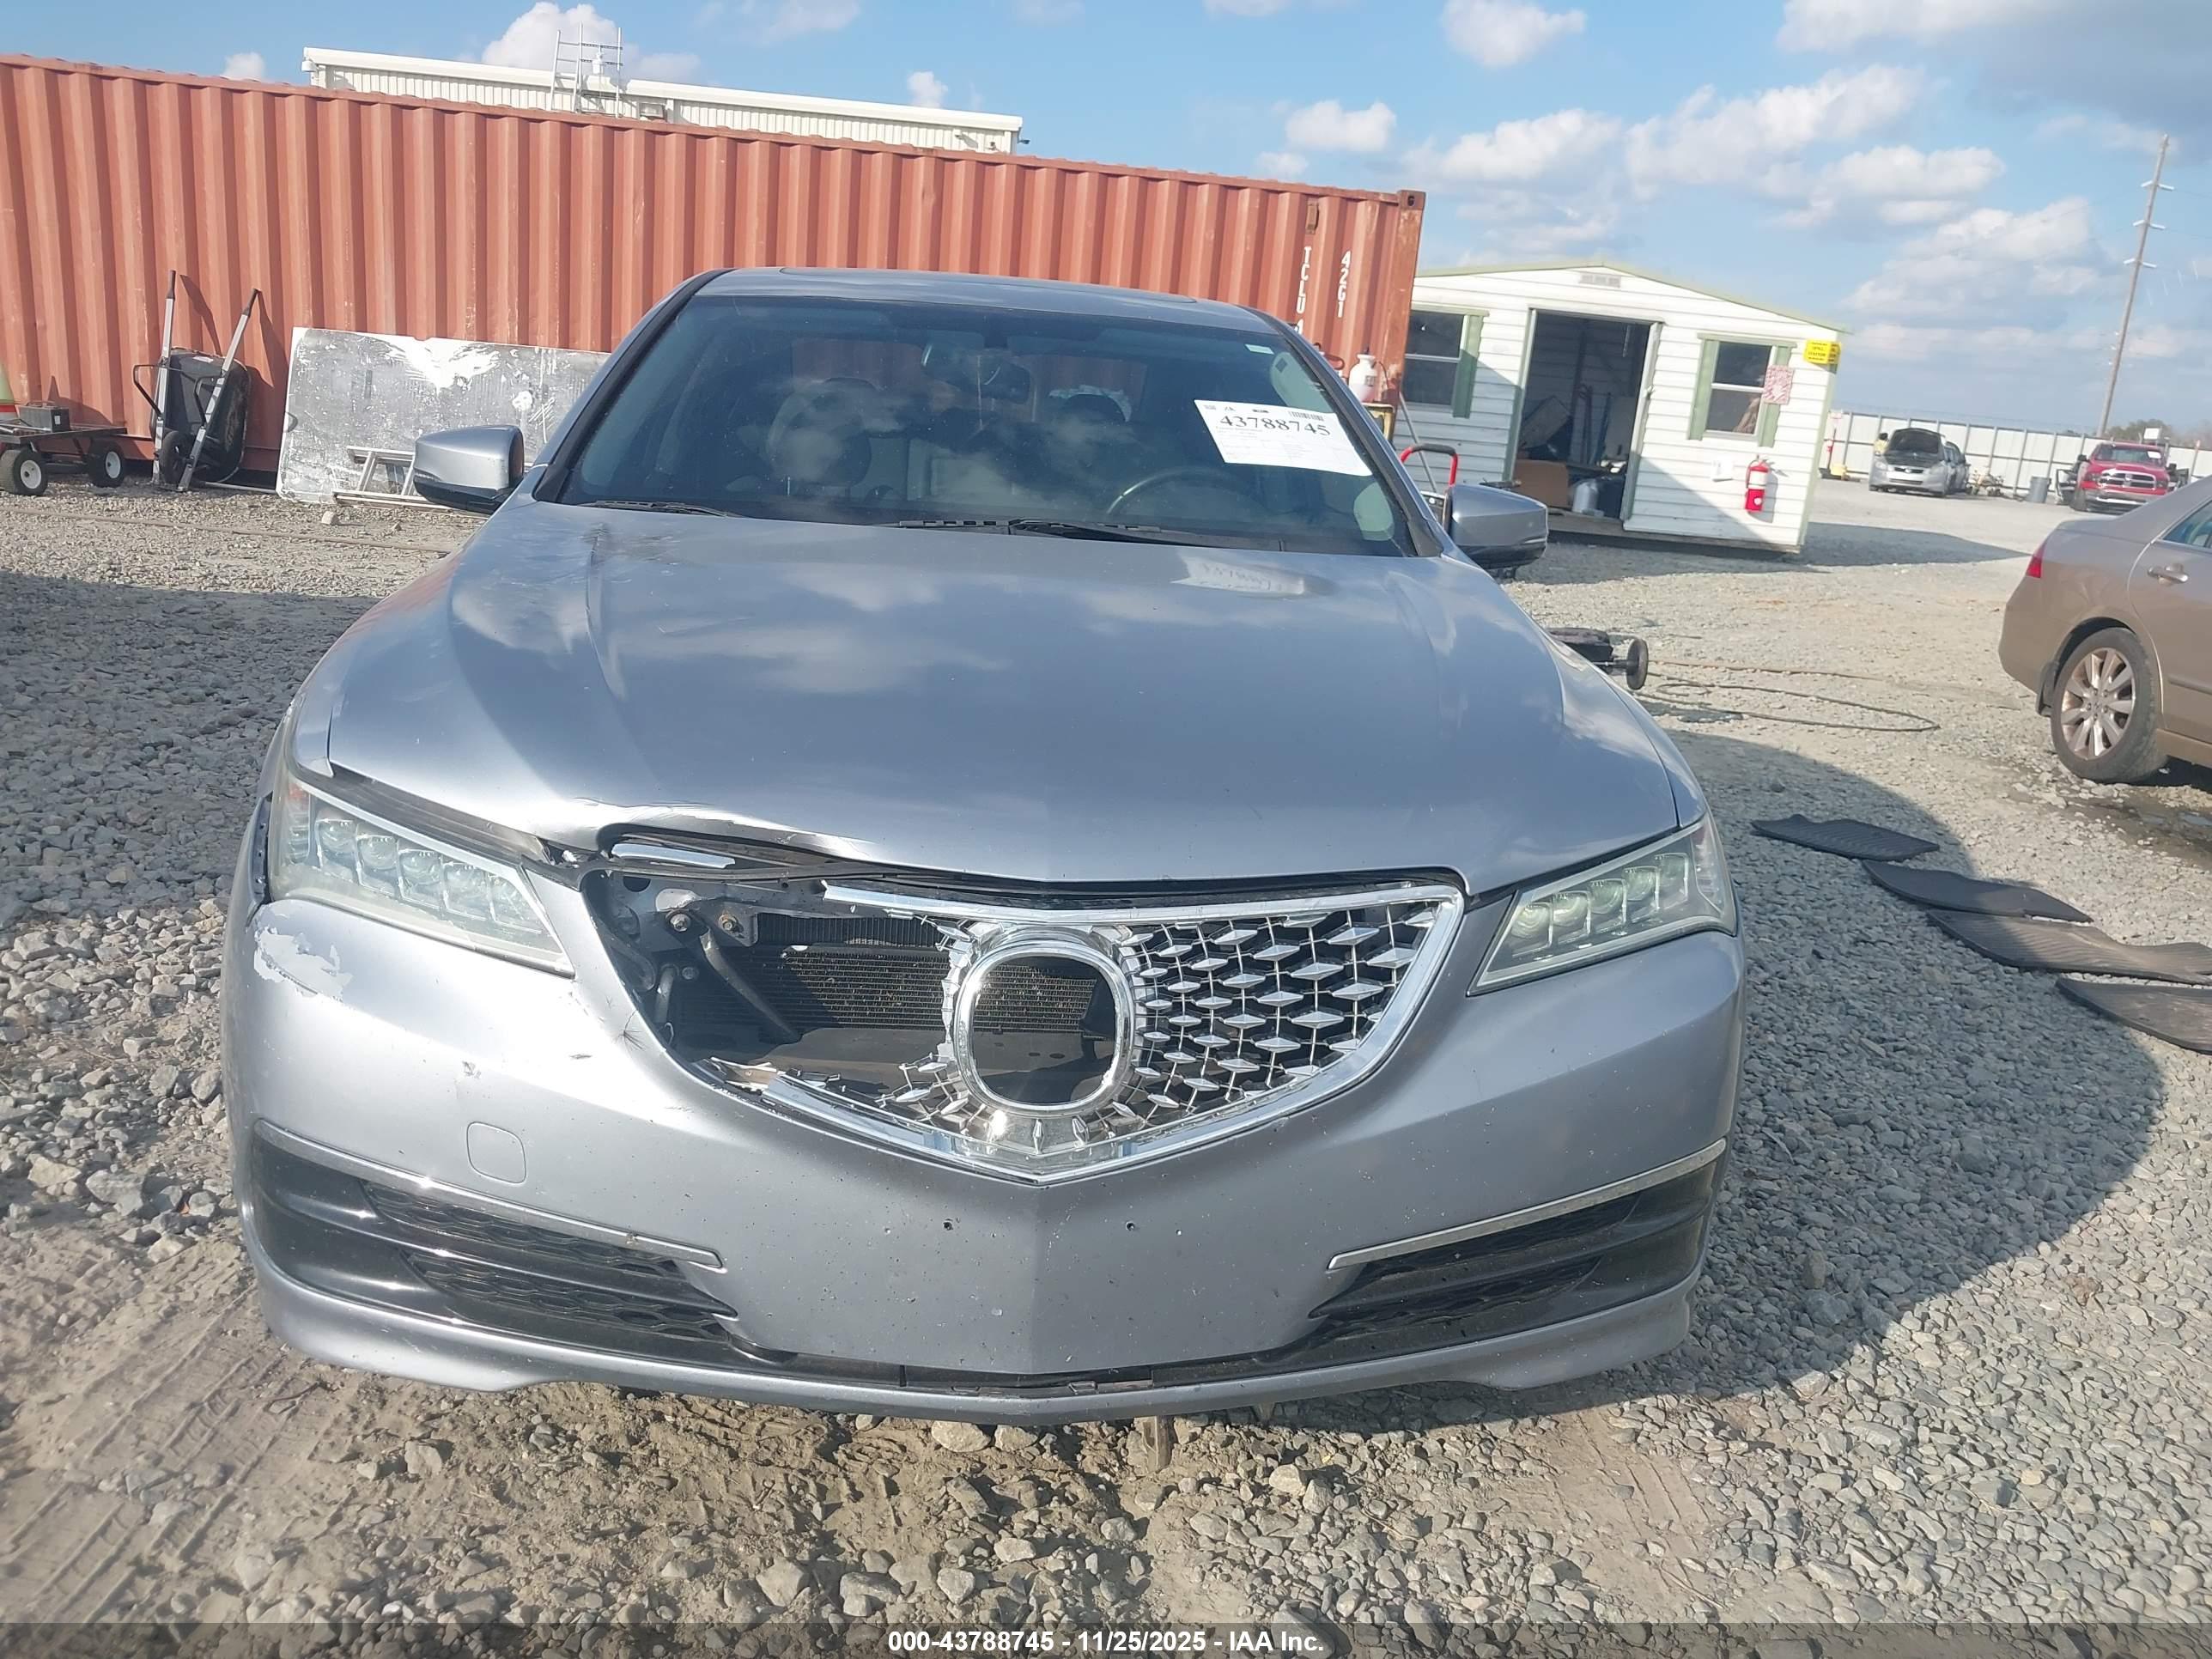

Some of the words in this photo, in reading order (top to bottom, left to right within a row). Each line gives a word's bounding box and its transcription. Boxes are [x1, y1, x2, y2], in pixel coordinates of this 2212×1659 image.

[1296, 246, 1312, 314] TCLU
[1337, 250, 1352, 318] 42G1
[1219, 415, 1331, 436] 43788745
